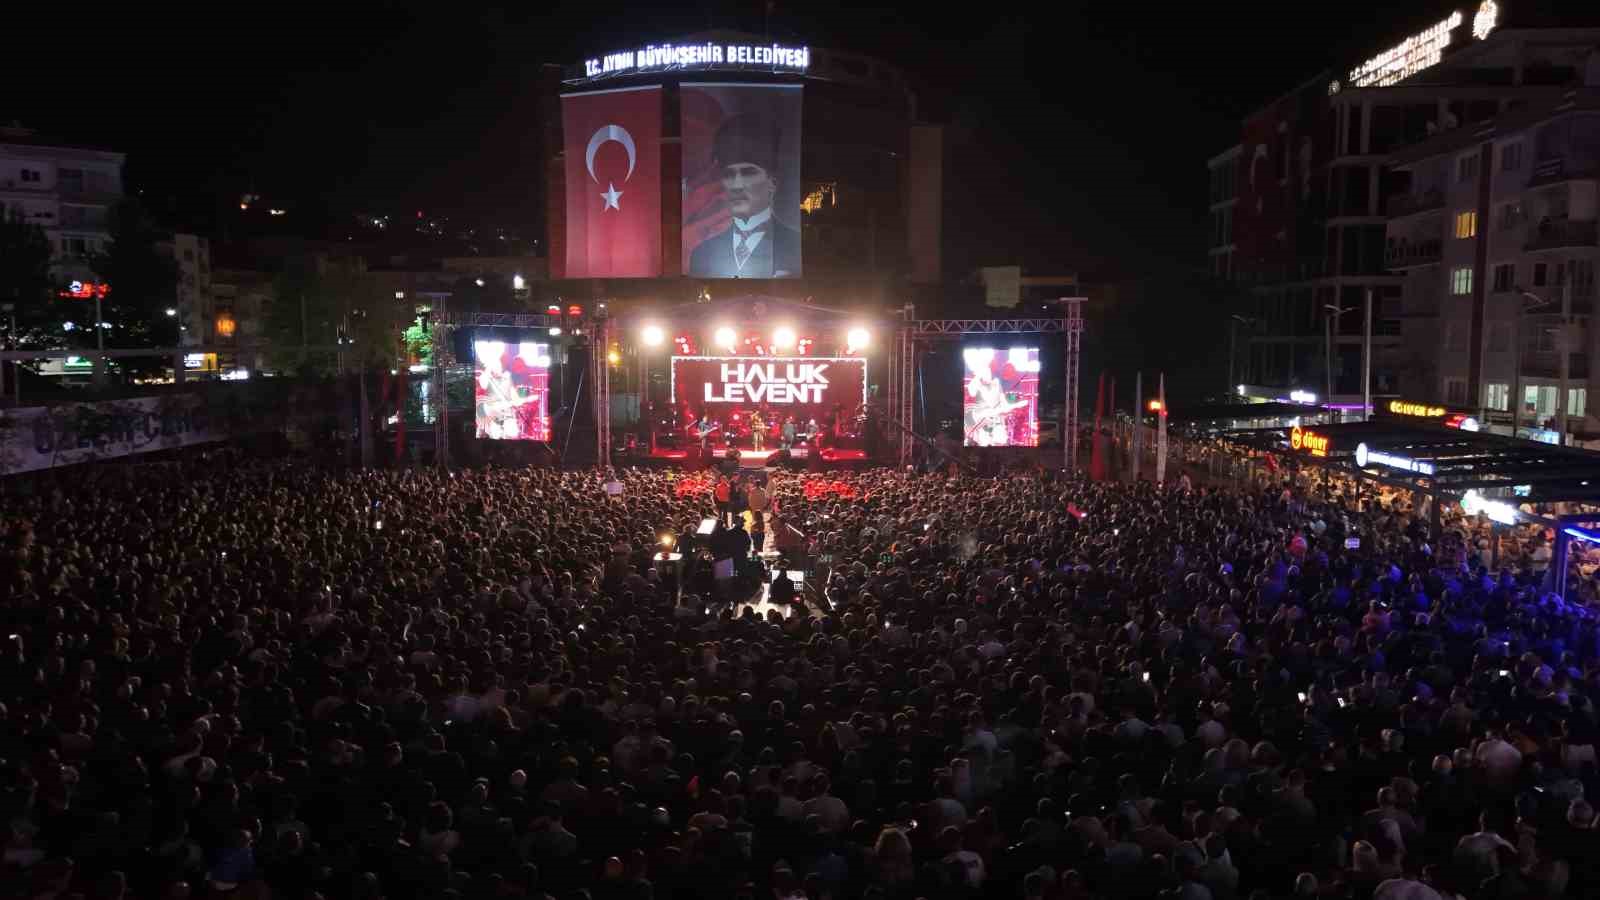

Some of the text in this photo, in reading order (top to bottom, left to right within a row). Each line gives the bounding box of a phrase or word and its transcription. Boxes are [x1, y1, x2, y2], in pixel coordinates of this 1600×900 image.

[602, 51, 634, 73] AYDIN
[637, 42, 723, 67] BÜYÜKŞEHİR
[727, 43, 808, 67] BELEDİYESİ
[720, 363, 830, 384] HALUK
[704, 382, 828, 403] LEVENT
[1303, 431, 1328, 451] döner
